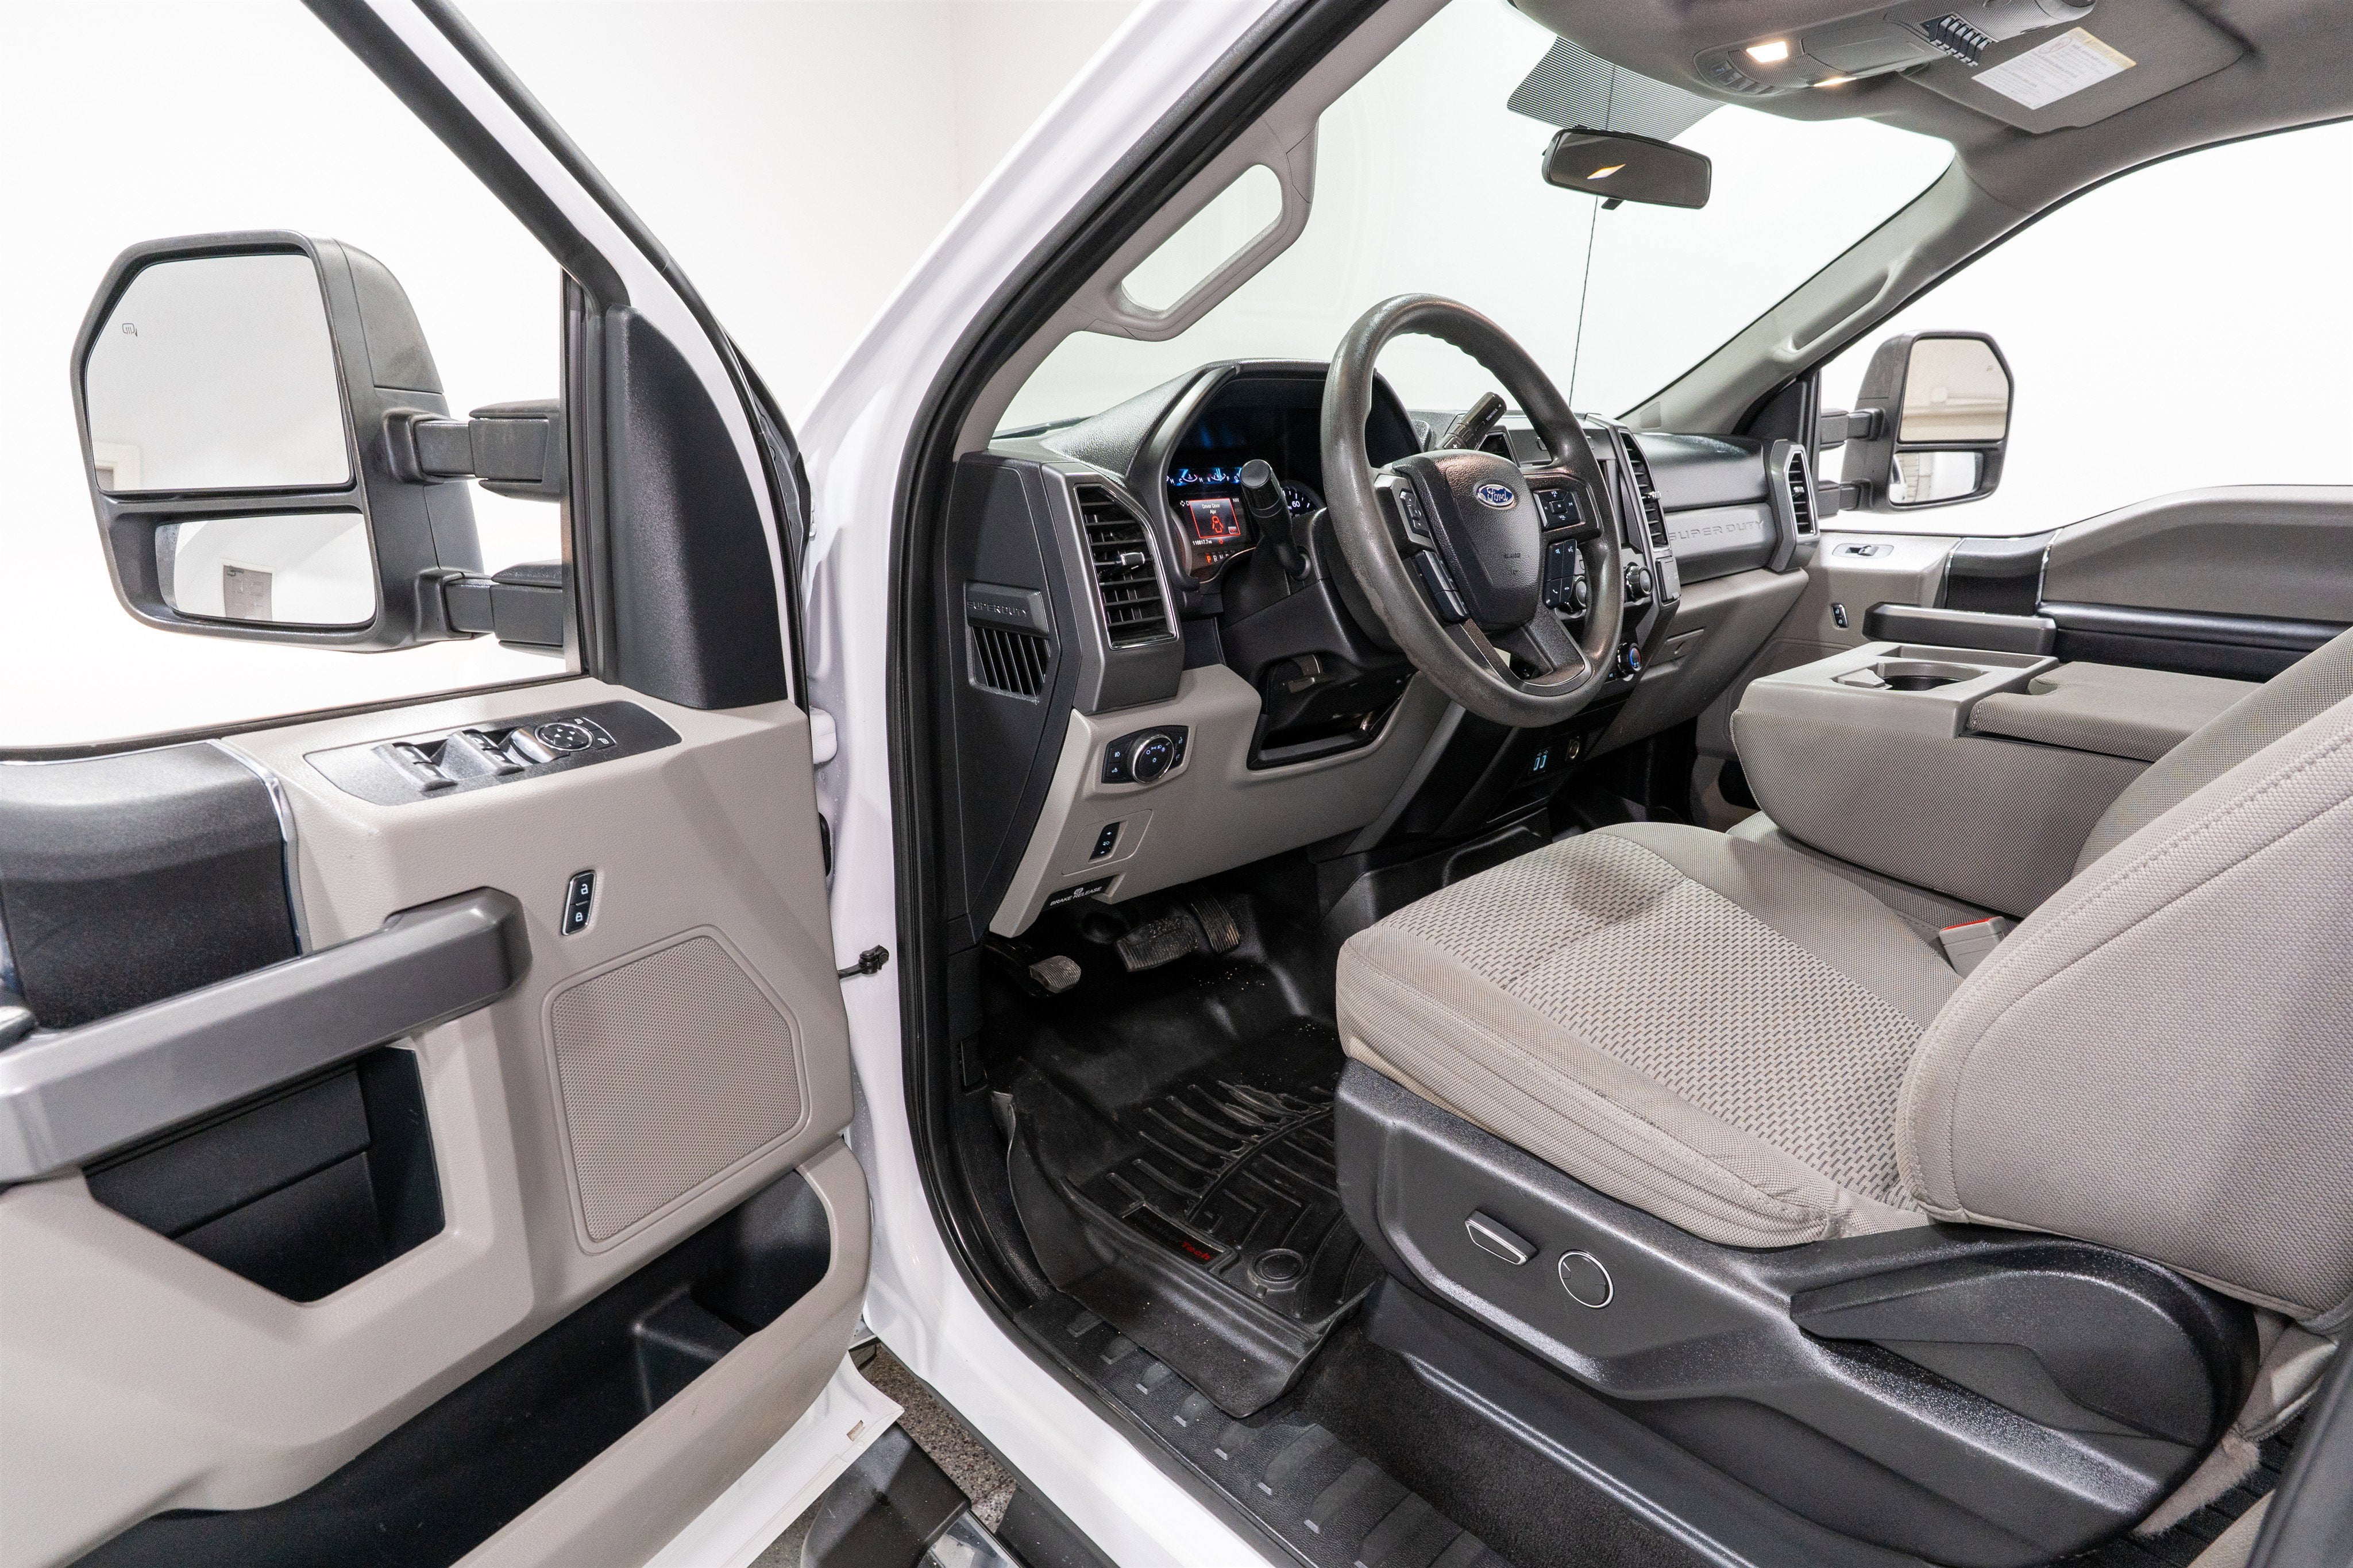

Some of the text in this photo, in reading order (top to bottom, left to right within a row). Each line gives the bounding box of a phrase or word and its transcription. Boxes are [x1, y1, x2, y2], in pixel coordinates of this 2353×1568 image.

[1486, 487, 1509, 501] Ford
[1668, 519, 1764, 541] SUPER DUTY
[1206, 555, 1212, 563] P
[967, 601, 1027, 617] SUPER DUTY
[1050, 886, 1102, 906] BRAKE RELEASE
